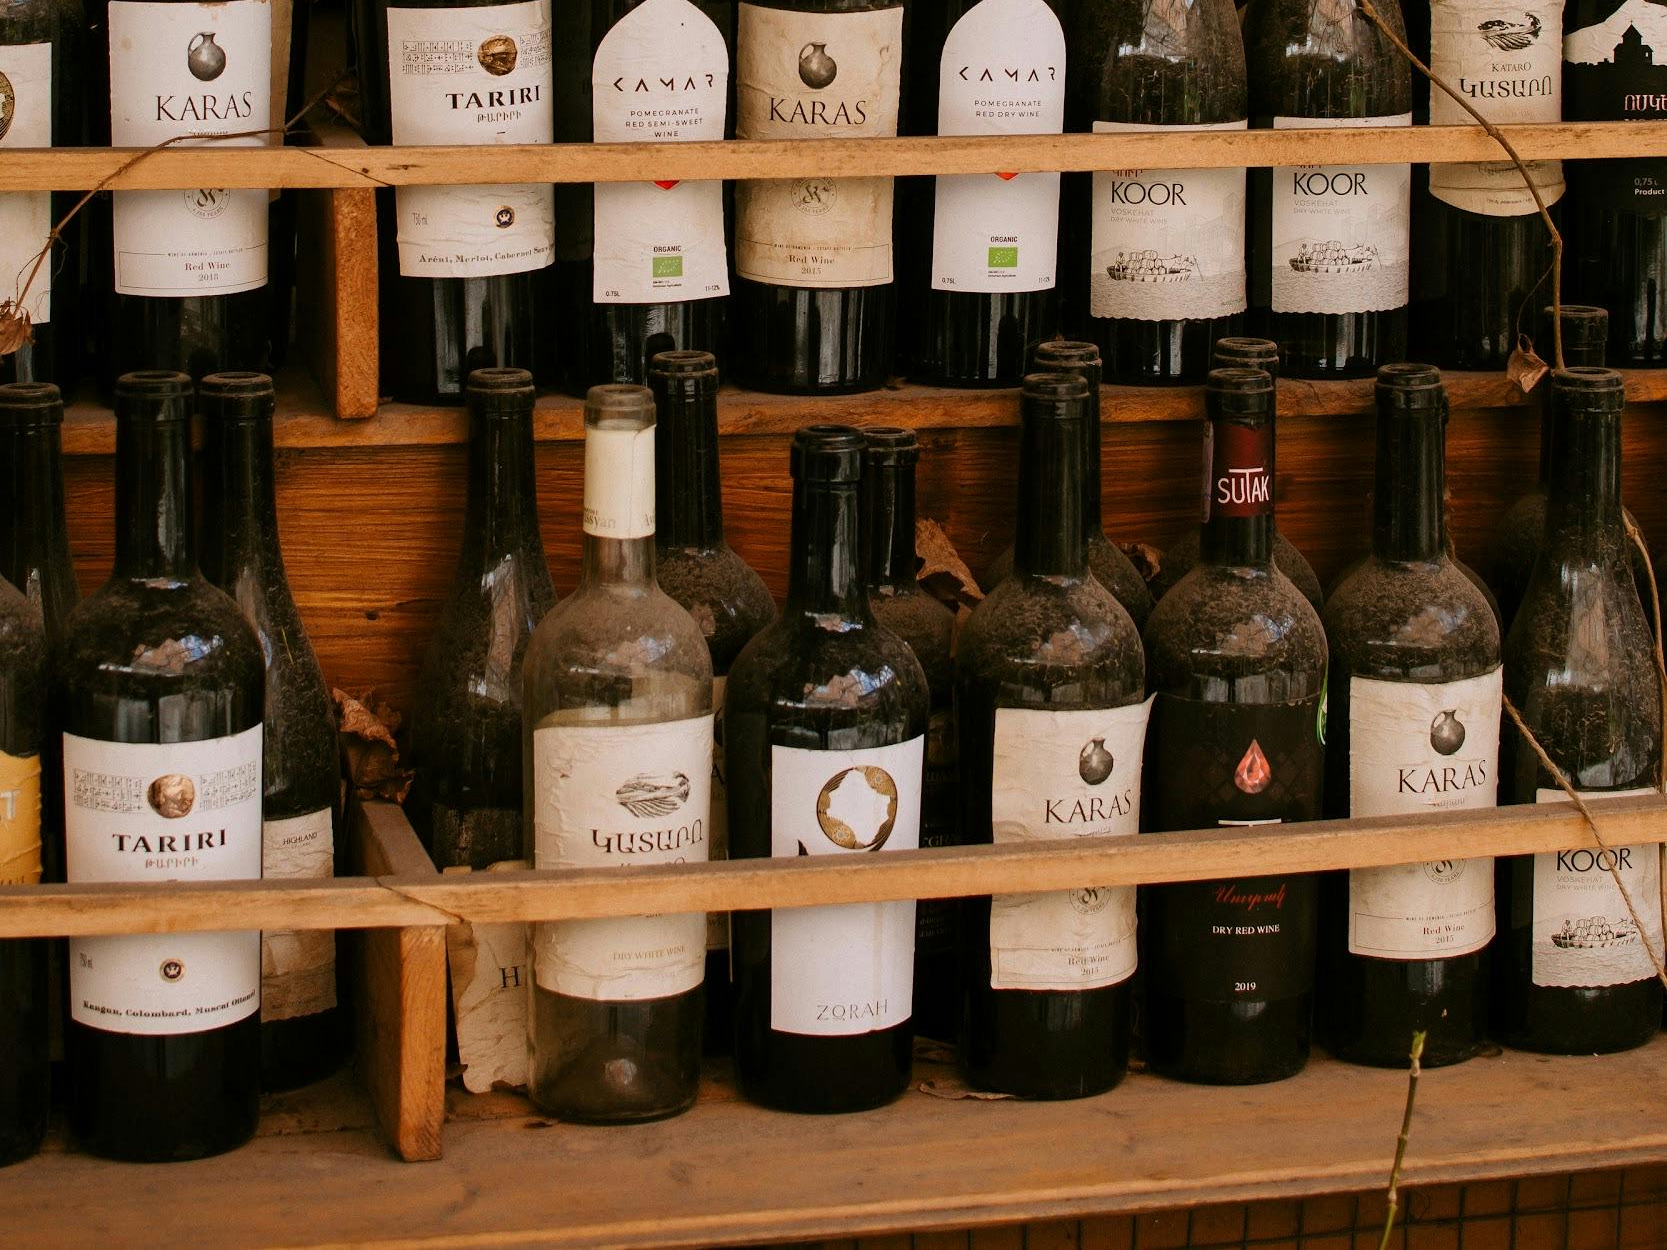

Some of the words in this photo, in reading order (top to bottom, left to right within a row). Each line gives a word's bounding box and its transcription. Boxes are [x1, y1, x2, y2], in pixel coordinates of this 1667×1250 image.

[959, 66, 1055, 82] KAMAR
[1492, 62, 1532, 72] KATARO
[613, 74, 714, 92] KAMAR
[445, 84, 540, 109] TARIRI
[157, 91, 252, 121] KARAS
[631, 108, 699, 117] POMEGRANATE
[769, 97, 866, 125] KARAS
[648, 118, 703, 127] SEMI-SWEET
[654, 130, 679, 138] WINE
[1294, 173, 1368, 196] KOOR
[1634, 188, 1665, 196] Product
[1111, 181, 1187, 205] KOOR
[653, 245, 682, 253] ORGANIC
[185, 262, 204, 271] Red
[208, 261, 230, 270] Wine
[789, 254, 807, 263] Red
[811, 255, 835, 264] Wine
[1217, 467, 1270, 504] SUTAK
[1398, 759, 1486, 793] KARAS
[1044, 789, 1131, 823] KARAS
[112, 828, 226, 853] TARIRI
[283, 831, 318, 846] HIGHLAND
[1557, 848, 1633, 872] KOOR
[1212, 925, 1233, 935] DRY
[1235, 926, 1255, 935] RED
[1257, 924, 1280, 934] WINE
[1423, 926, 1441, 935] Red
[1445, 924, 1465, 932] Wine
[1068, 957, 1087, 966] Red
[1090, 954, 1110, 963] Wine
[1234, 981, 1256, 991] 2019
[126, 1008, 191, 1018] Colombard,
[817, 998, 888, 1021] ZORAH
